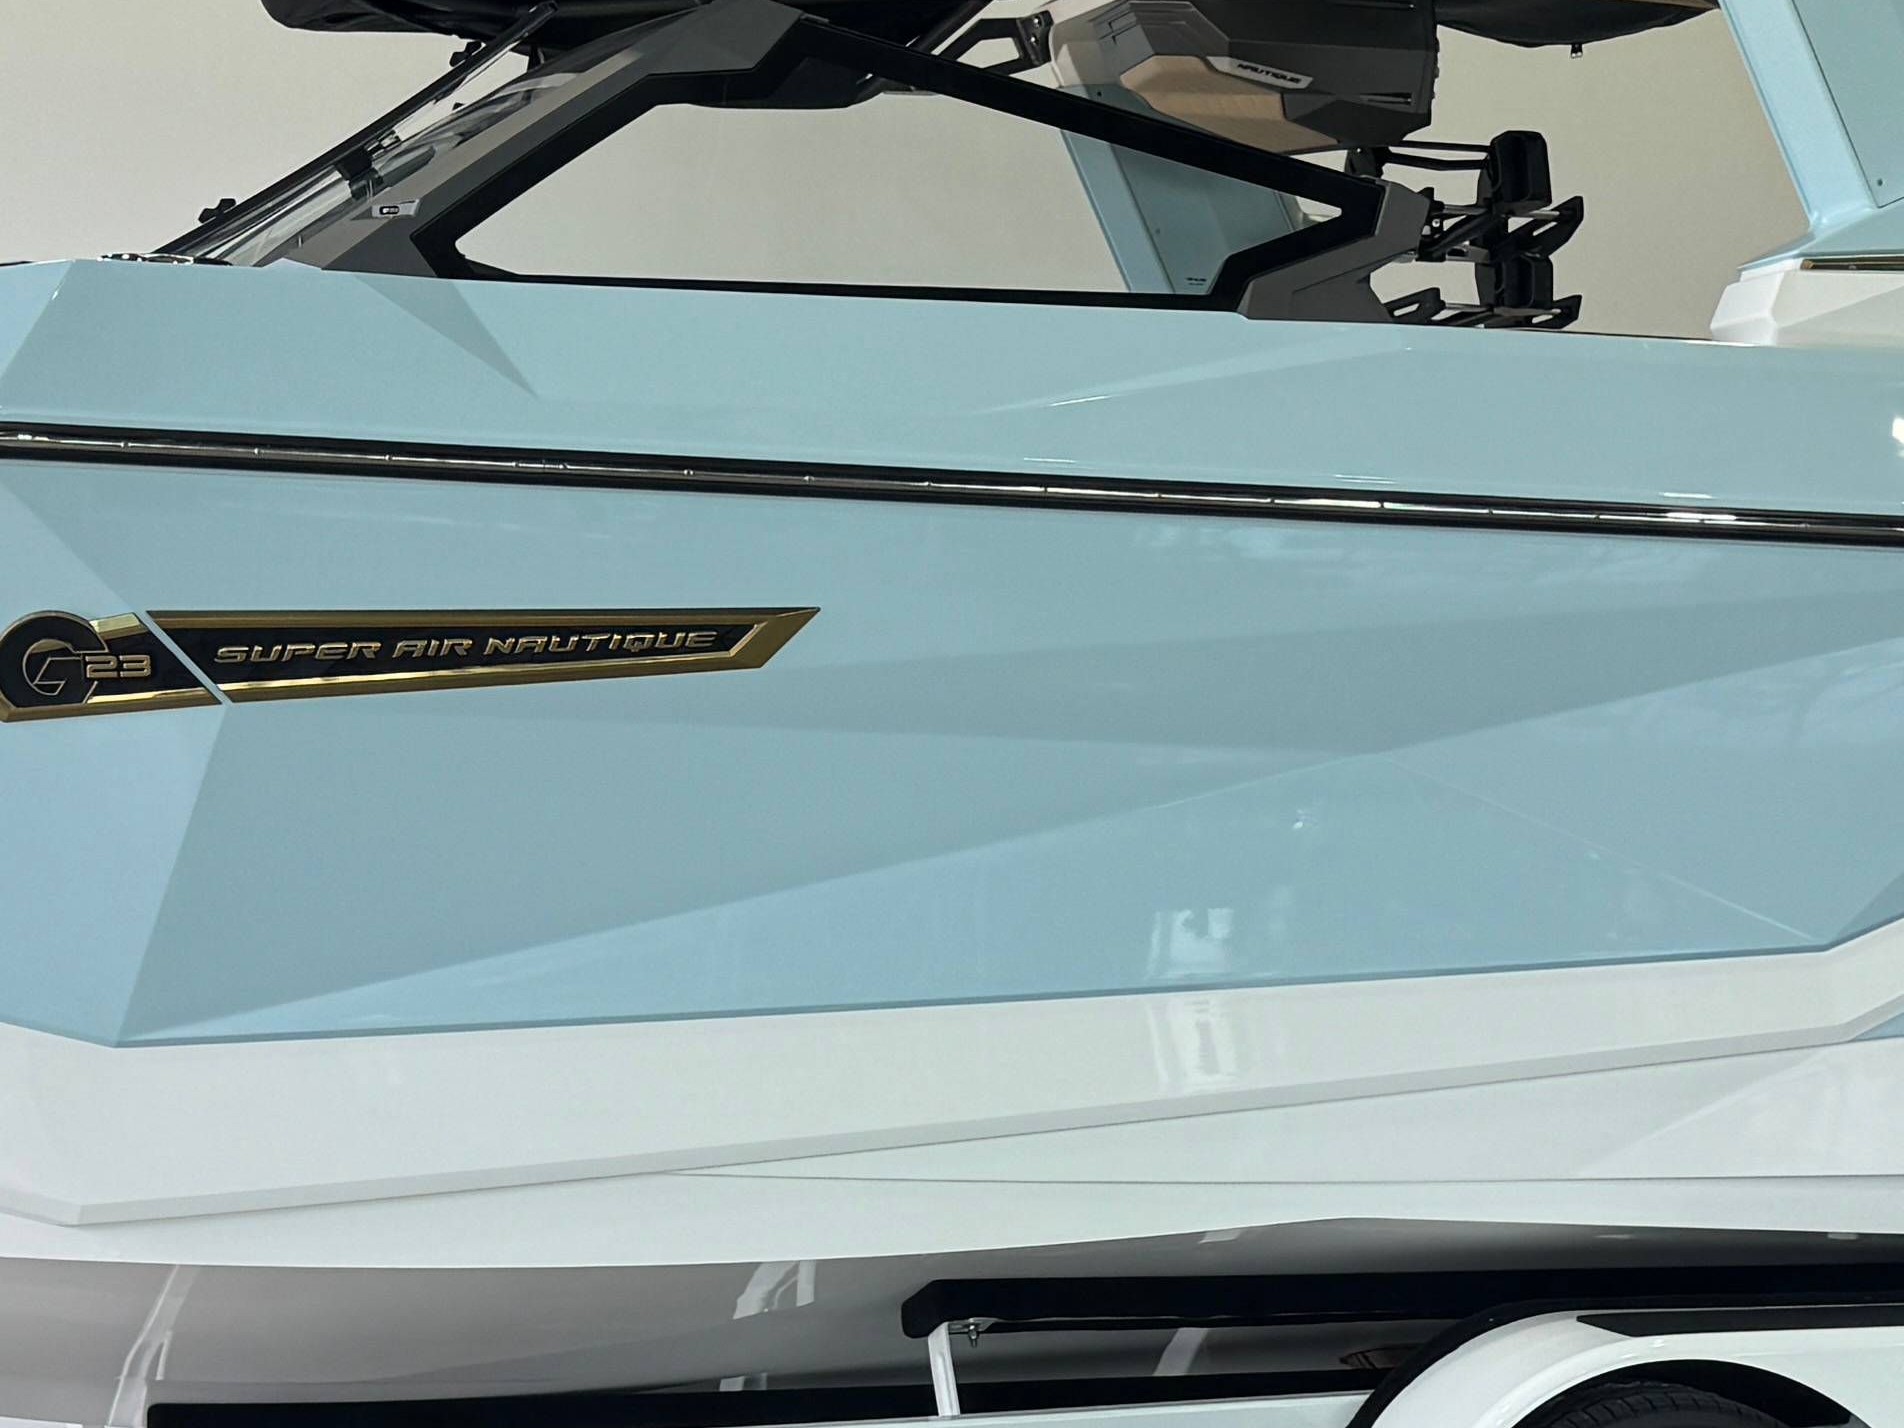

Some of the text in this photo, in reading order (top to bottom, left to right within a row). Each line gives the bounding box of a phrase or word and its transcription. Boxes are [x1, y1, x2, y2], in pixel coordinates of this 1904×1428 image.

[213, 641, 383, 664] SUPER
[392, 637, 474, 659] AIR
[483, 630, 720, 656] NAUTIQUE
